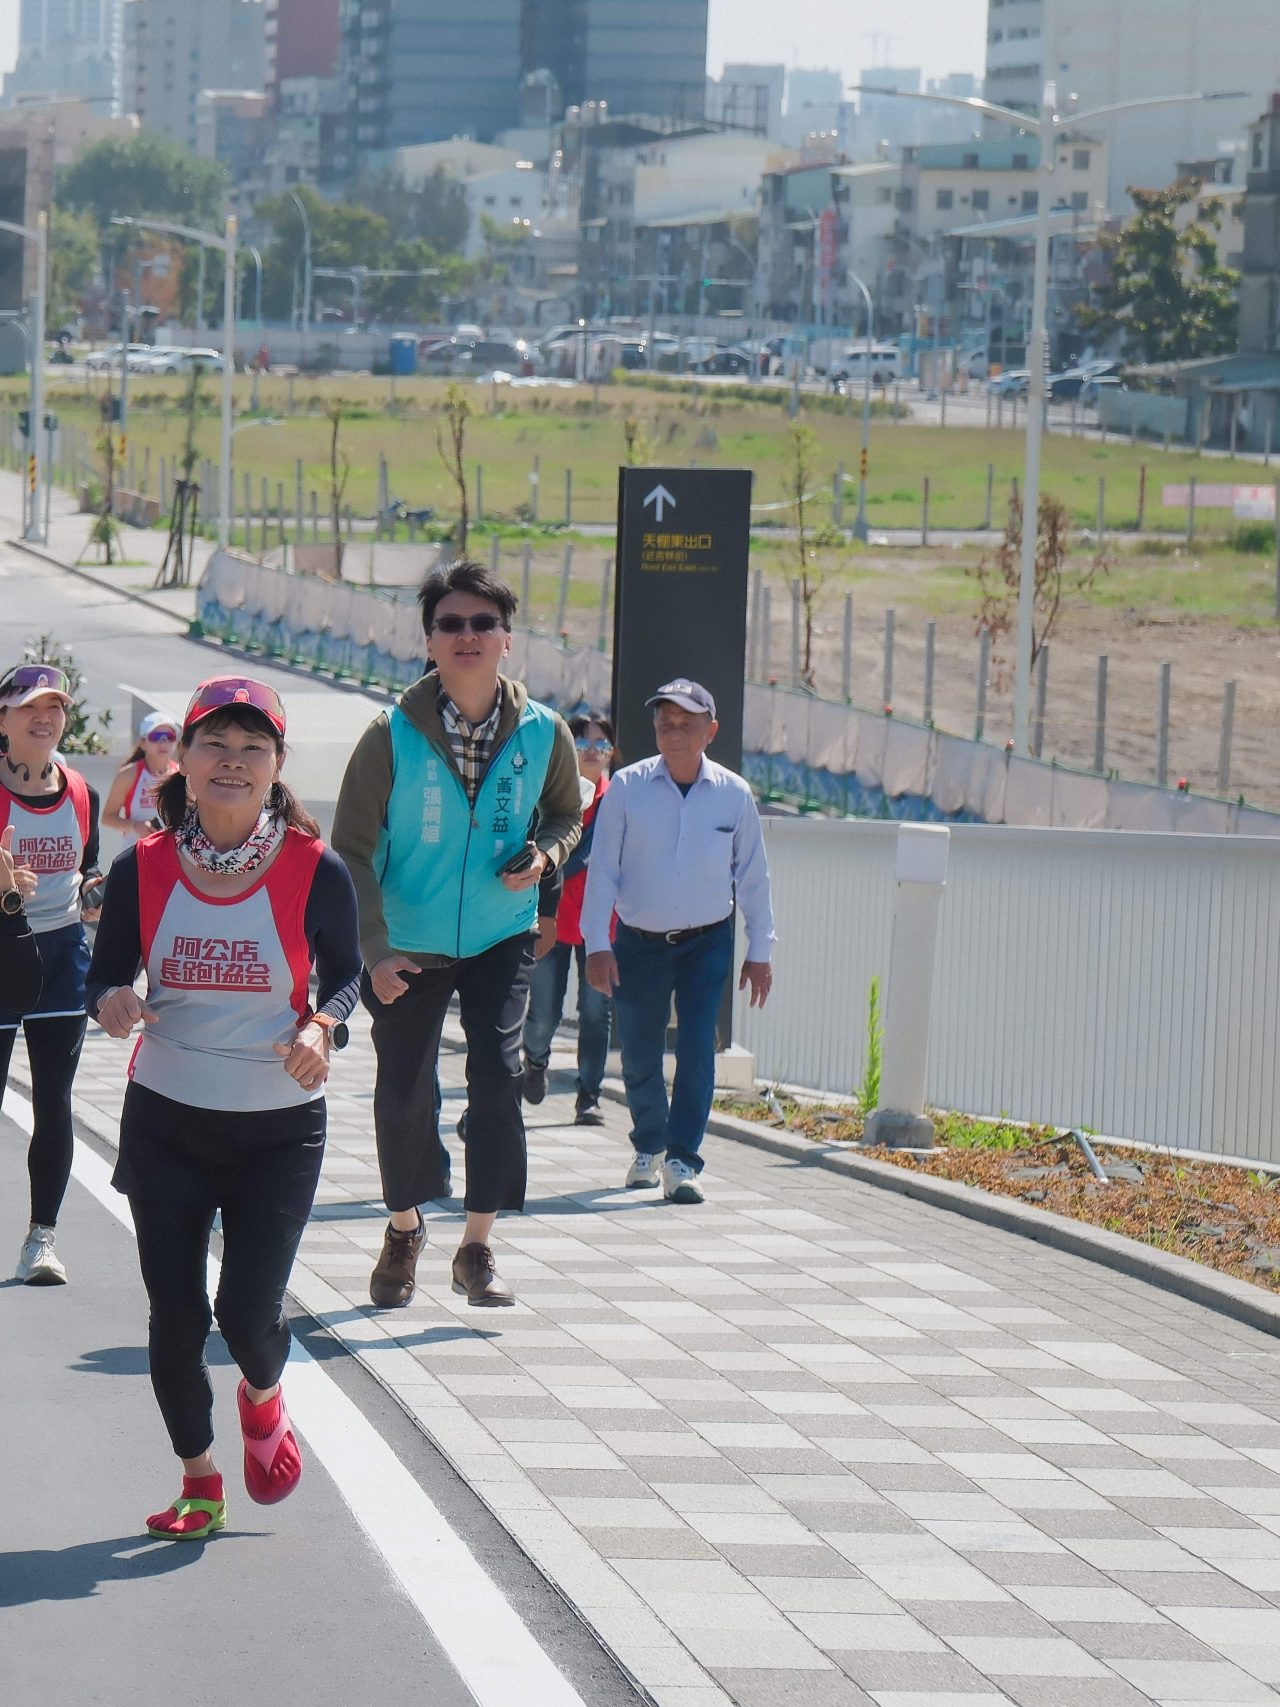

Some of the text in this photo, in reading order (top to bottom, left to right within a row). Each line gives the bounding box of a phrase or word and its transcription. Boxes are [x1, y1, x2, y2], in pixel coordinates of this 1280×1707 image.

[491, 777, 512, 832] 黃文益
[19, 836, 73, 854] 阿公店
[172, 936, 260, 962] 阿公店
